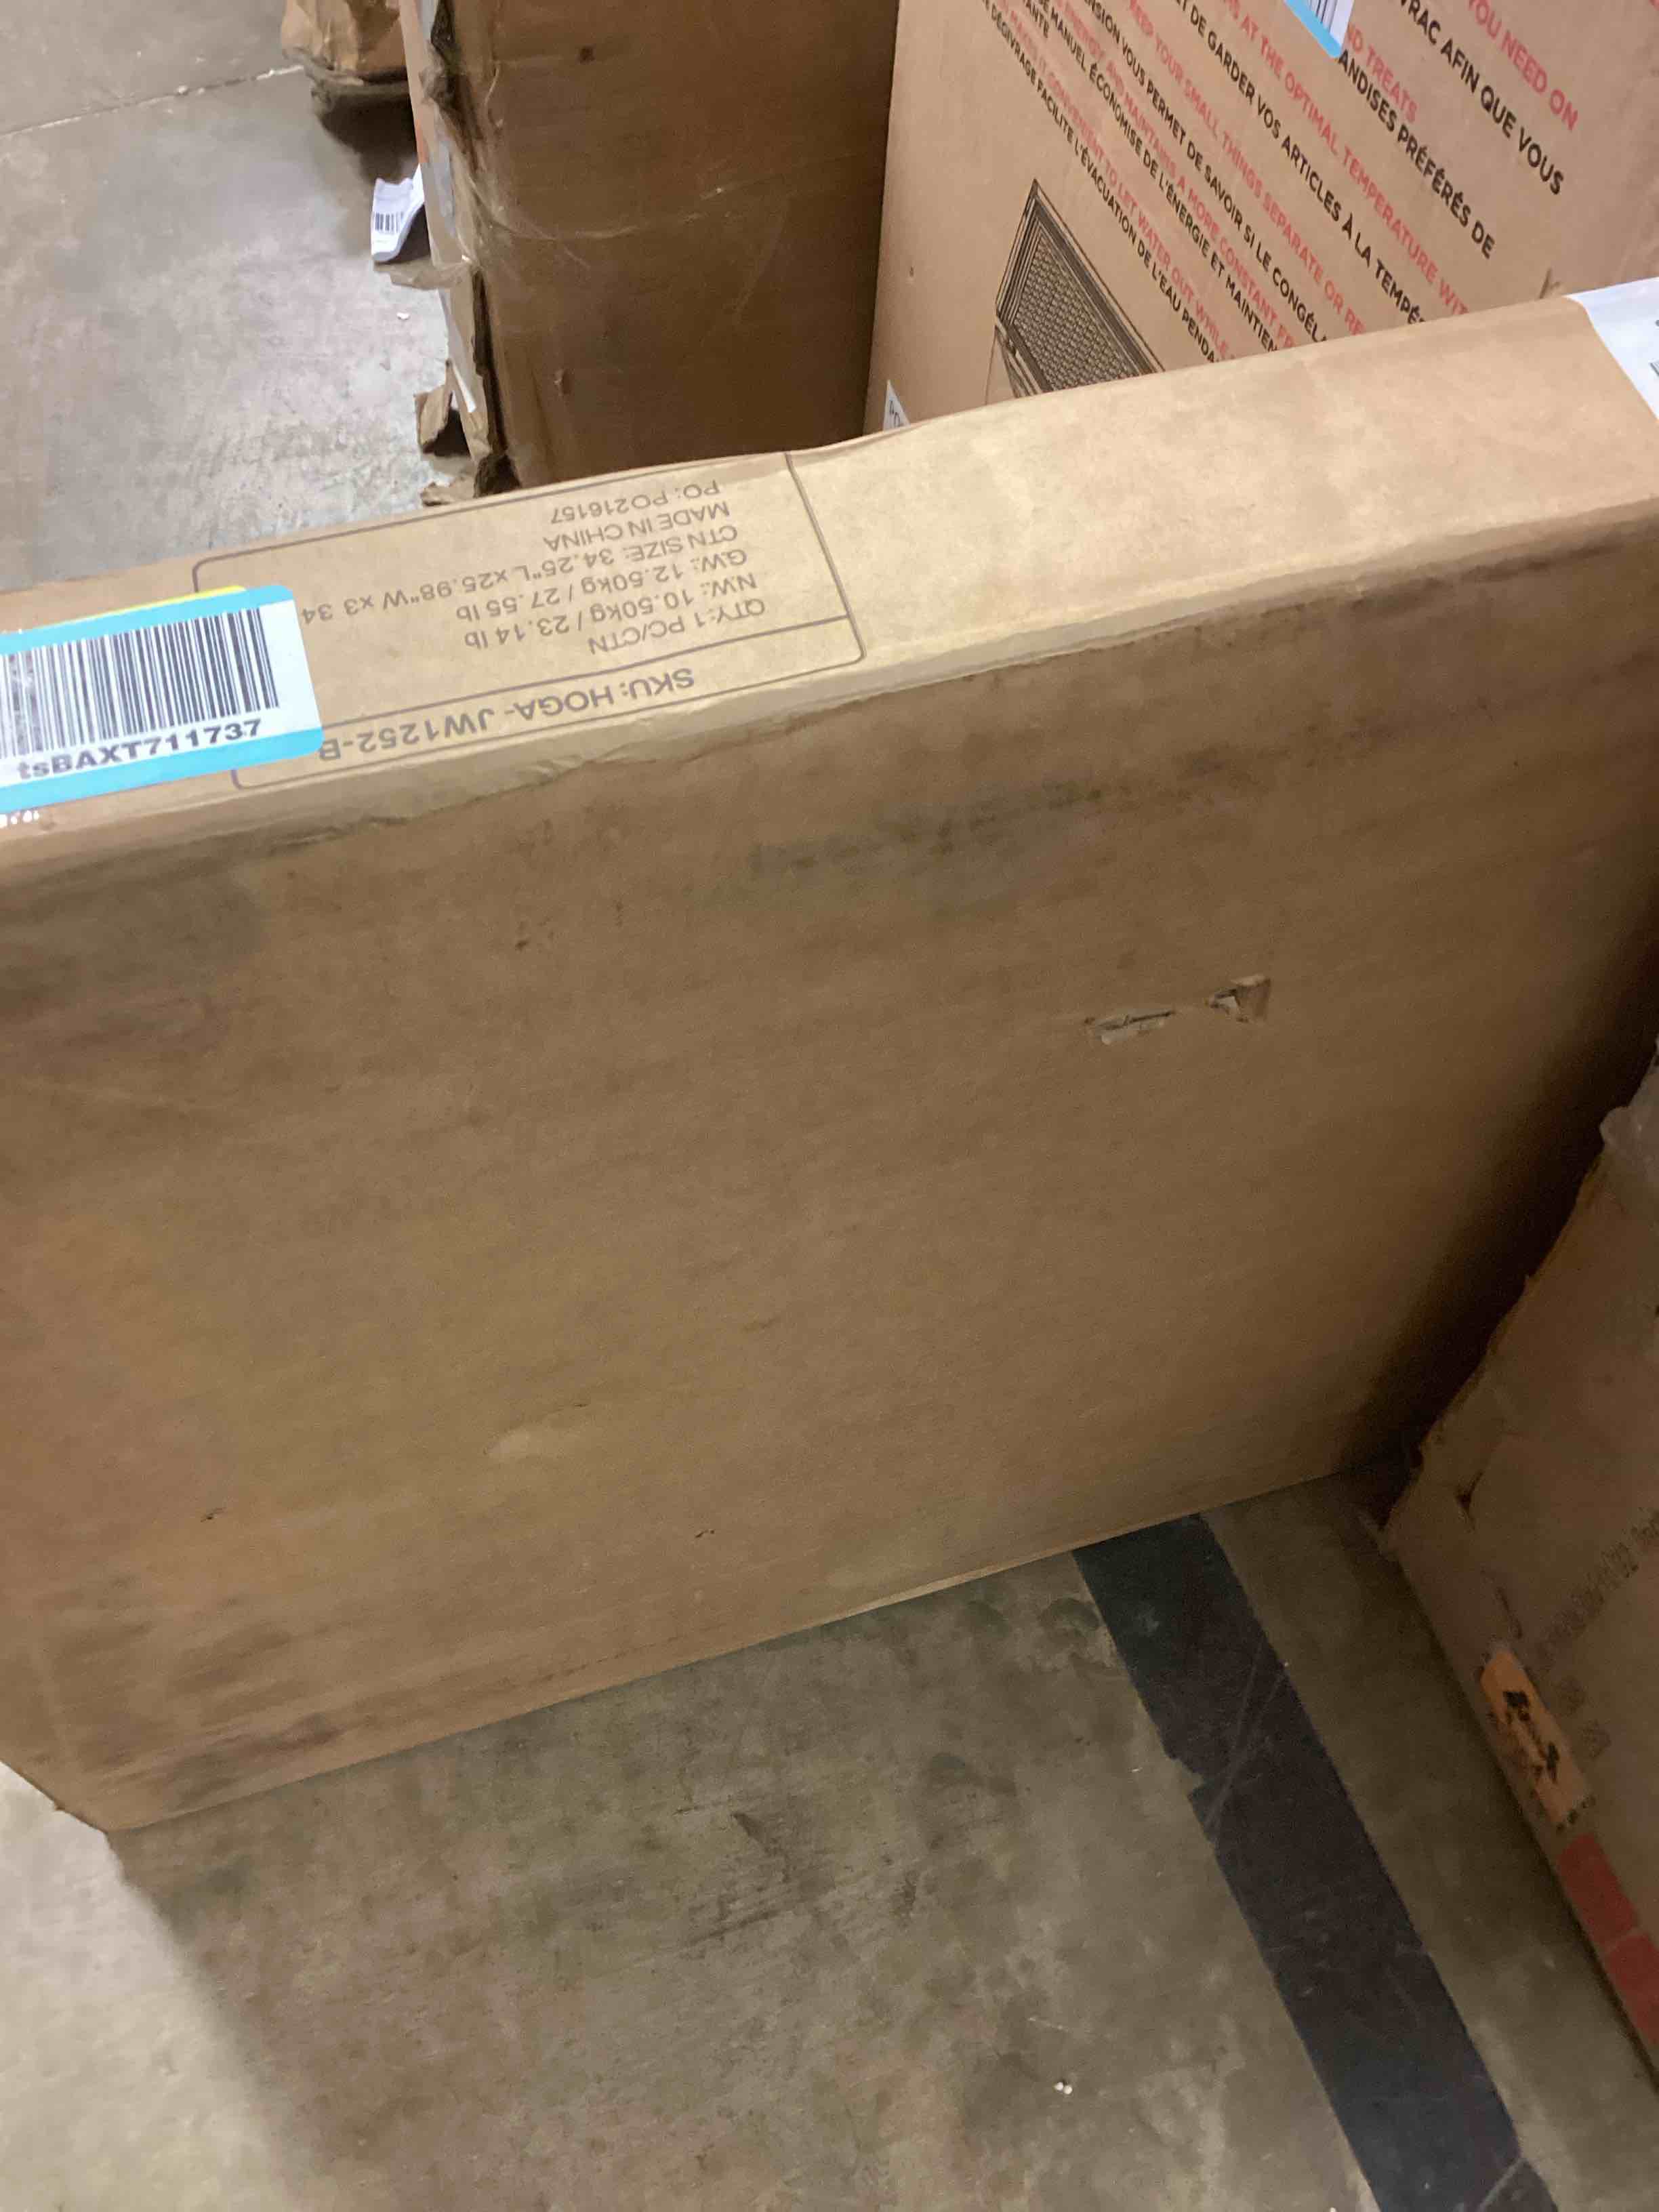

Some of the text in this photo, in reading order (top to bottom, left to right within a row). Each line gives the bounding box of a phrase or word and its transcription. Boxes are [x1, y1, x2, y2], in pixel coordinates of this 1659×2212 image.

[1366, 44, 1417, 123] TREATS
[1501, 30, 1547, 93] NEED
[1549, 89, 1578, 130] ON
[1050, 7, 1086, 73] MANUEL
[1089, 62, 1143, 158] ÉCONOMISE
[1143, 148, 1159, 180] DE
[1159, 170, 1210, 258] L'ÉNERGIE
[1210, 251, 1225, 278] ET
[1441, 39, 1480, 93] AFIN
[1481, 85, 1517, 139] QUE
[1518, 127, 1564, 195] VOUS
[1155, 33, 1184, 85] YOUR
[1184, 79, 1218, 138] SMALL
[1223, 130, 1263, 199] THINGS
[1263, 192, 1323, 285] SEPARATE
[1324, 279, 1344, 314] OR
[1190, 5, 1207, 38] DE
[1208, 30, 1255, 106] GARDER
[1256, 94, 1281, 140] VOS
[1281, 135, 1342, 222] ARTICLES
[1342, 211, 1353, 240] À
[1355, 232, 1371, 268] LA
[1375, 258, 1426, 325] TEMPÉ
[1241, 14, 1258, 41] AT
[1261, 36, 1286, 80] THE
[1285, 71, 1338, 156] OPTIMAL
[1343, 145, 1438, 284] TEMPERATURE
[1439, 279, 1469, 315] WIT
[1338, 49, 1495, 259] ANDISES PRÉFÉRÉS DE
[1122, 37, 1145, 86] VOUS
[1146, 79, 1186, 146] PERMET
[1187, 140, 1203, 172] DE
[1204, 164, 1243, 230] SAVOIR
[1244, 224, 1255, 249] SI
[1256, 241, 1271, 272] LE
[1273, 267, 1327, 342] CONGÉL
[1037, 79, 1073, 143] FACILITE
[1075, 137, 1136, 245] L'ÉVACUATION
[1137, 239, 1151, 269] DE
[1152, 262, 1181, 312] L'EAU
[1182, 307, 1219, 364] PENDA
[1106, 160, 1118, 188] TO
[1118, 182, 1139, 217] LET
[1138, 211, 1172, 271] WATER
[1171, 266, 1194, 304] OUT
[1176, 175, 1186, 191] A
[1187, 187, 1220, 242] MORE
[1220, 237, 1277, 327] CONSTANT
[543, 501, 730, 552] MADE IN CHINA
[550, 480, 720, 525] PO: PO216157
[623, 539, 683, 562] SIZE:
[688, 525, 738, 550] CTN
[486, 588, 560, 617] 27.55
[568, 583, 573, 602] /
[581, 563, 683, 594] 12.50kg
[590, 589, 694, 622] 10.50kg
[456, 604, 480, 623] lb
[464, 630, 488, 650] lb
[495, 615, 569, 644] 23.14
[577, 610, 582, 632] /
[588, 615, 685, 655] PC/CTN
[319, 668, 695, 762] SKU: HOGA- JW1252-B
[16, 718, 262, 781] tsBAXT711737
